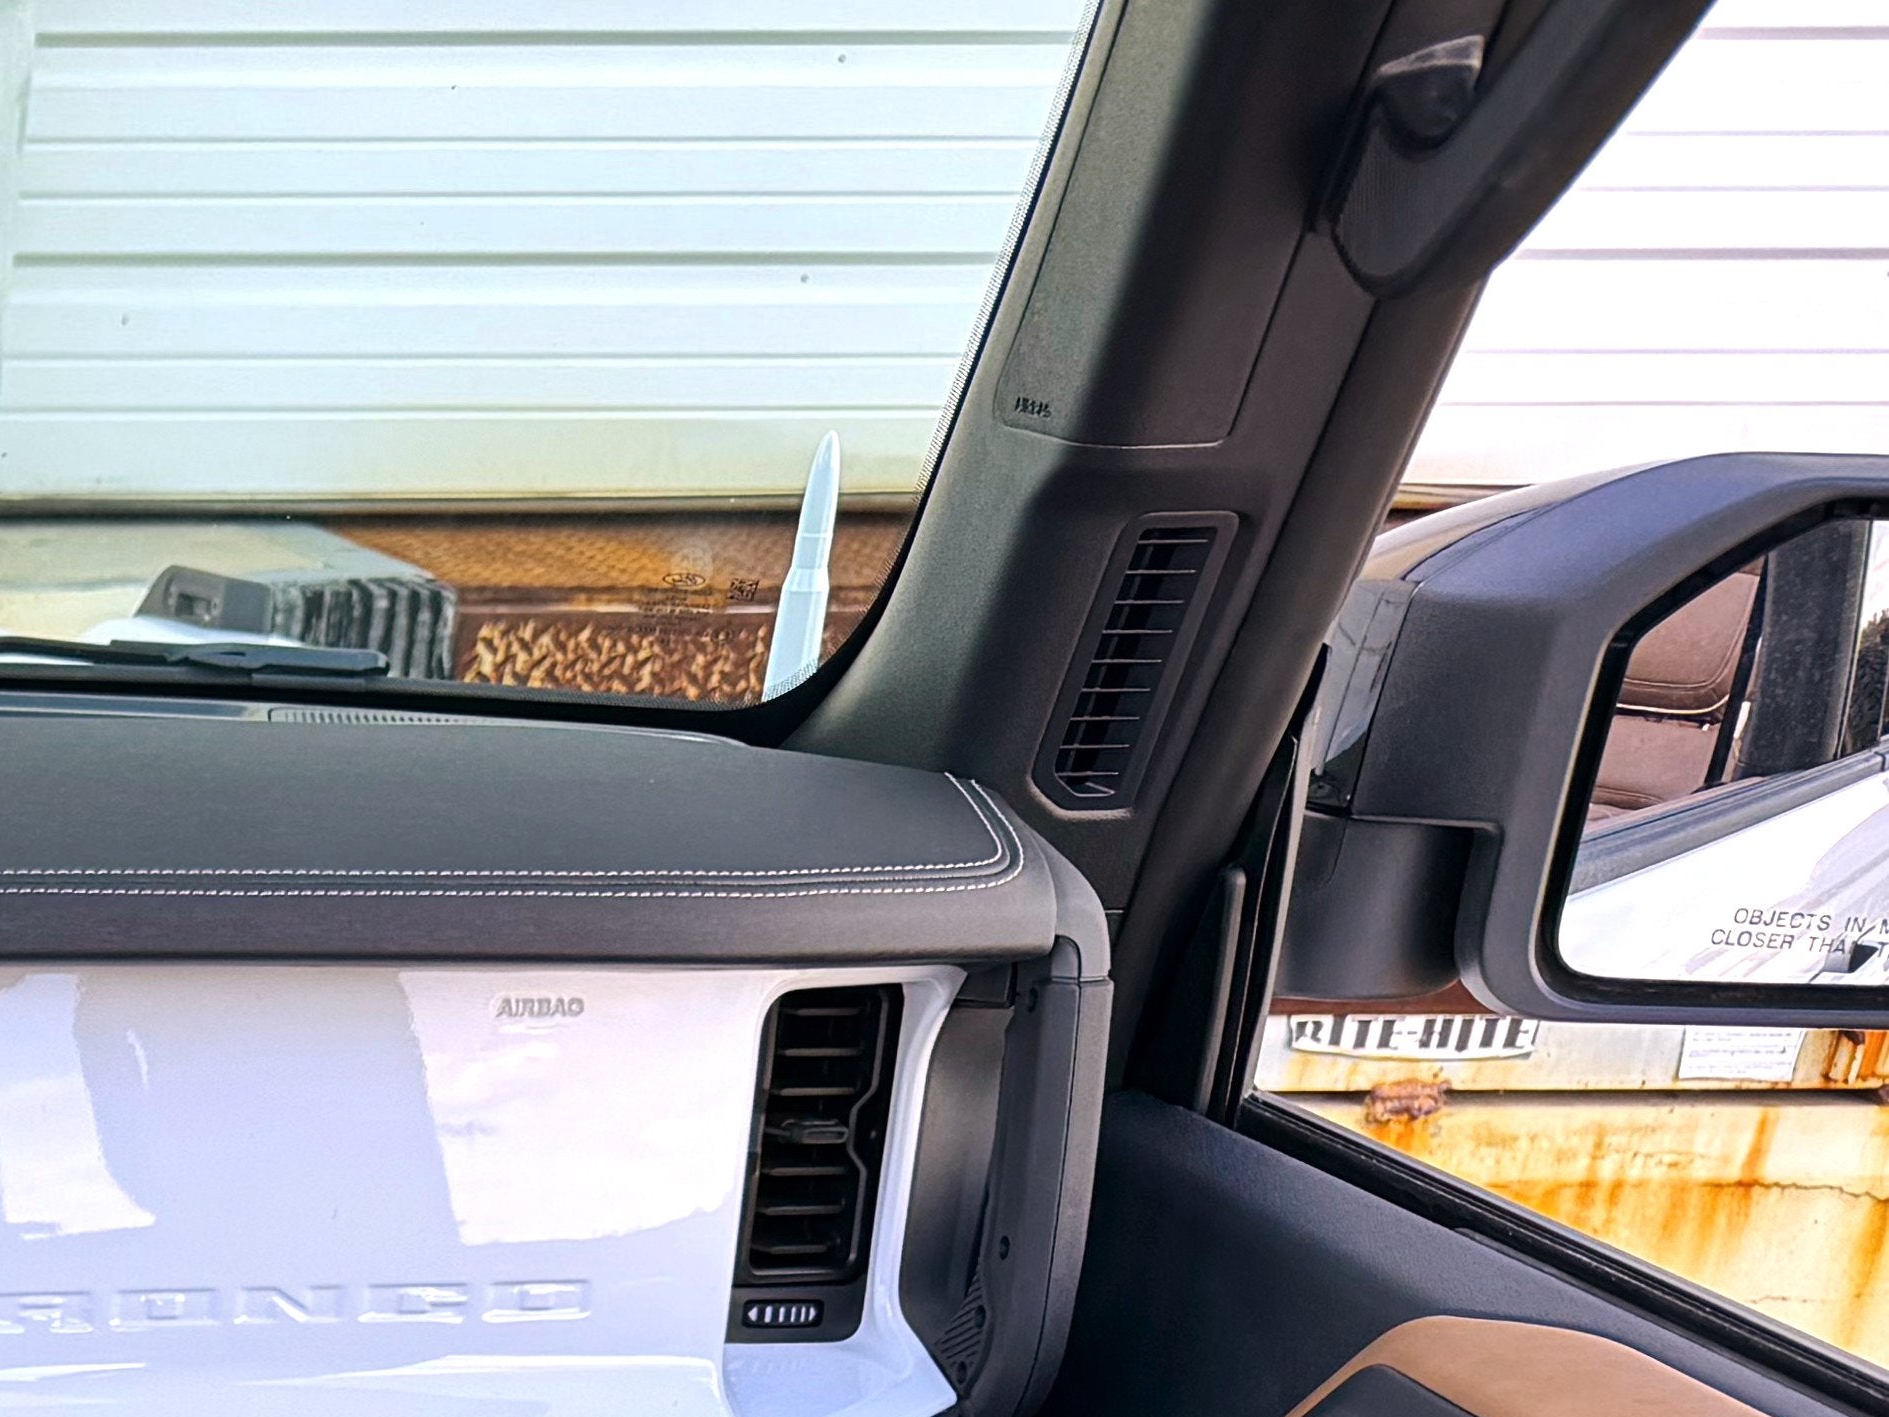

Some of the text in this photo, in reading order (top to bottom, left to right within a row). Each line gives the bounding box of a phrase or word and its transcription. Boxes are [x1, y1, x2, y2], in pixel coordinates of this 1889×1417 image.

[1734, 908, 1832, 932] OBJECTS
[1845, 917, 1867, 933] IN
[1711, 929, 1795, 950] CLOSER
[495, 996, 585, 1018] AIRBAG
[1293, 1017, 1534, 1051] RITE-HITE
